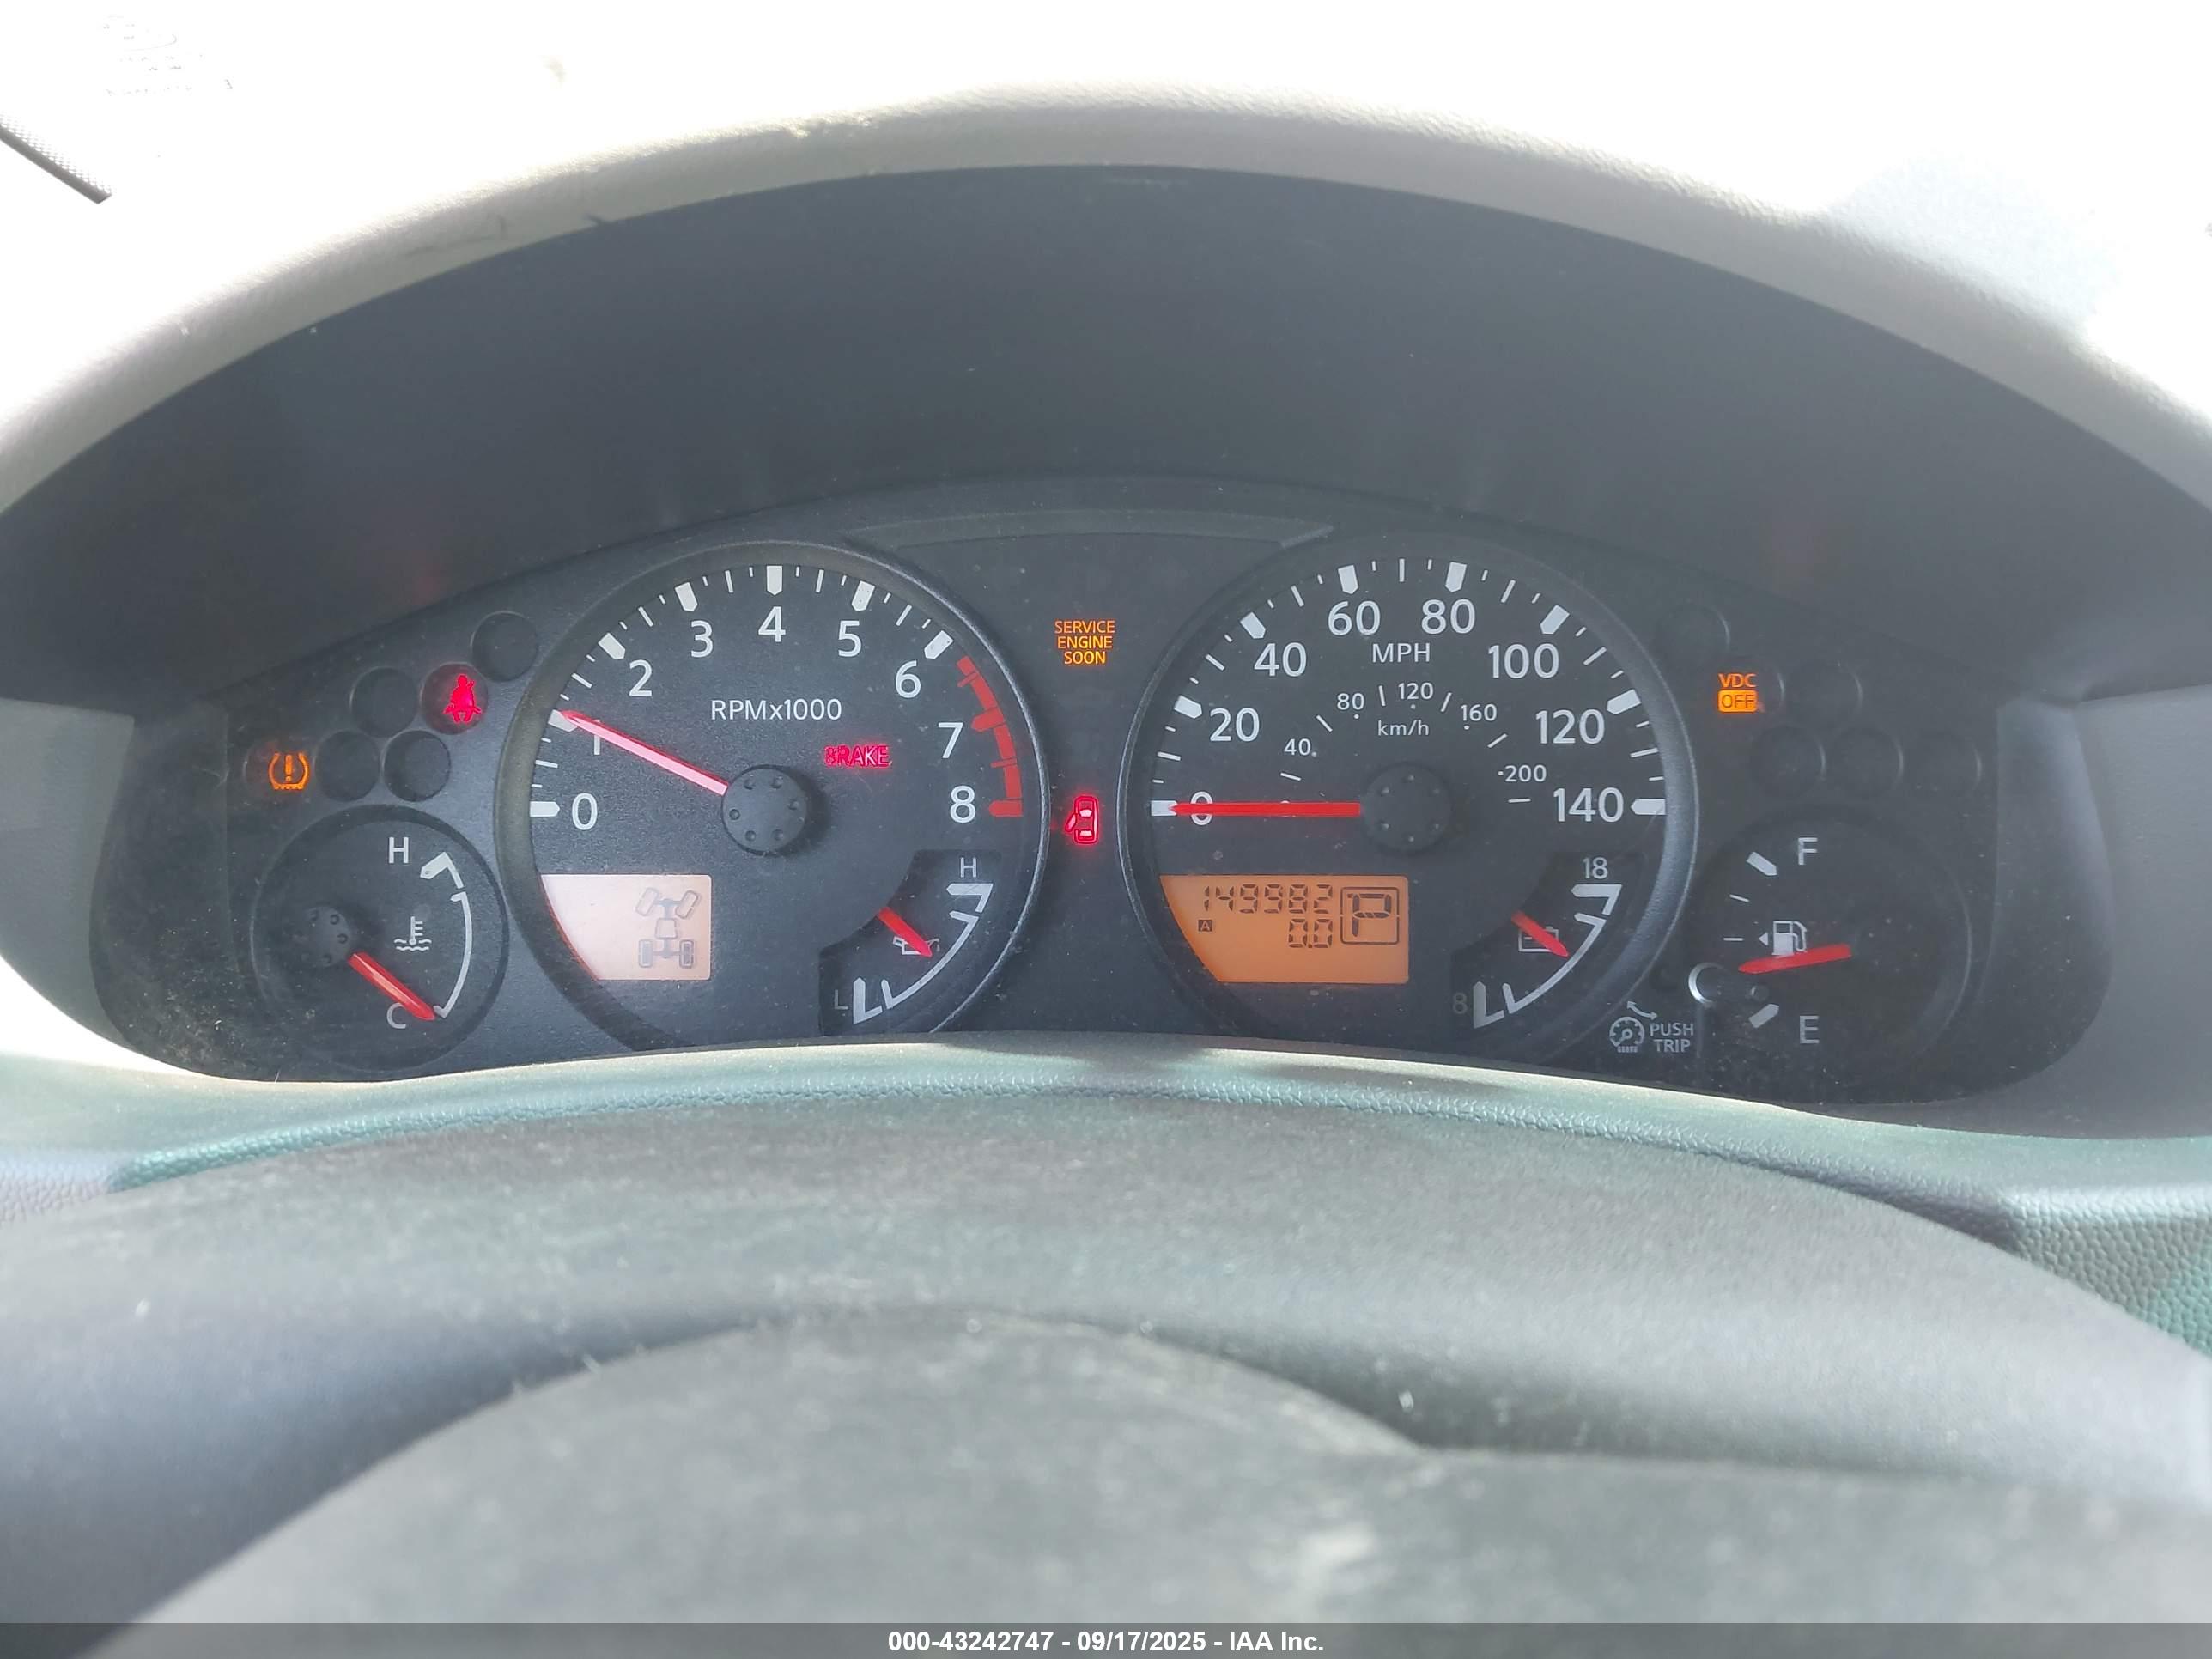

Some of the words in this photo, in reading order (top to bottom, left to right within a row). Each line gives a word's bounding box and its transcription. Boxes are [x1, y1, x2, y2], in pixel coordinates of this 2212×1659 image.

[758, 606, 786, 641] 4
[1055, 621, 1115, 633] SERVICE
[1328, 601, 1380, 635] 60
[1422, 599, 1474, 634] 80
[691, 621, 713, 657] 3
[839, 621, 861, 657] 5
[1058, 635, 1112, 648] ENGINE
[1065, 651, 1105, 664] SOON
[1255, 642, 1306, 676] 40
[1373, 643, 1430, 662] MPH
[1488, 644, 1559, 678] 100
[629, 659, 652, 696] 2
[896, 660, 921, 698] 6
[1718, 673, 1757, 689] VDC
[1338, 693, 1364, 709] 80
[1399, 683, 1433, 699] 120
[1721, 693, 1755, 708] OFF
[712, 699, 841, 720] RPMx1000
[1462, 704, 1497, 720] 160
[1211, 708, 1259, 741] 20
[1378, 720, 1428, 735] km/h
[1536, 709, 1604, 744] 120
[939, 722, 963, 758] 7
[1285, 738, 1310, 755] 40
[824, 744, 890, 767] BRAKE
[1505, 765, 1546, 781] 200
[572, 793, 597, 830] 0
[951, 786, 975, 823] 8
[1191, 792, 1212, 825] 0
[1553, 787, 1623, 822] 140
[389, 837, 409, 863] H
[1798, 837, 1817, 865] F
[961, 858, 976, 878] H
[1583, 857, 1608, 878] 18
[1205, 884, 1333, 914] 149982
[1347, 894, 1392, 937] P
[1289, 919, 1333, 948] 0.0
[835, 989, 848, 1010] L
[1453, 993, 1468, 1014] 8
[387, 1003, 406, 1029] C
[1650, 1023, 1693, 1036] PUSH
[1800, 1016, 1819, 1043] E
[1653, 1039, 1690, 1052] TRIP
